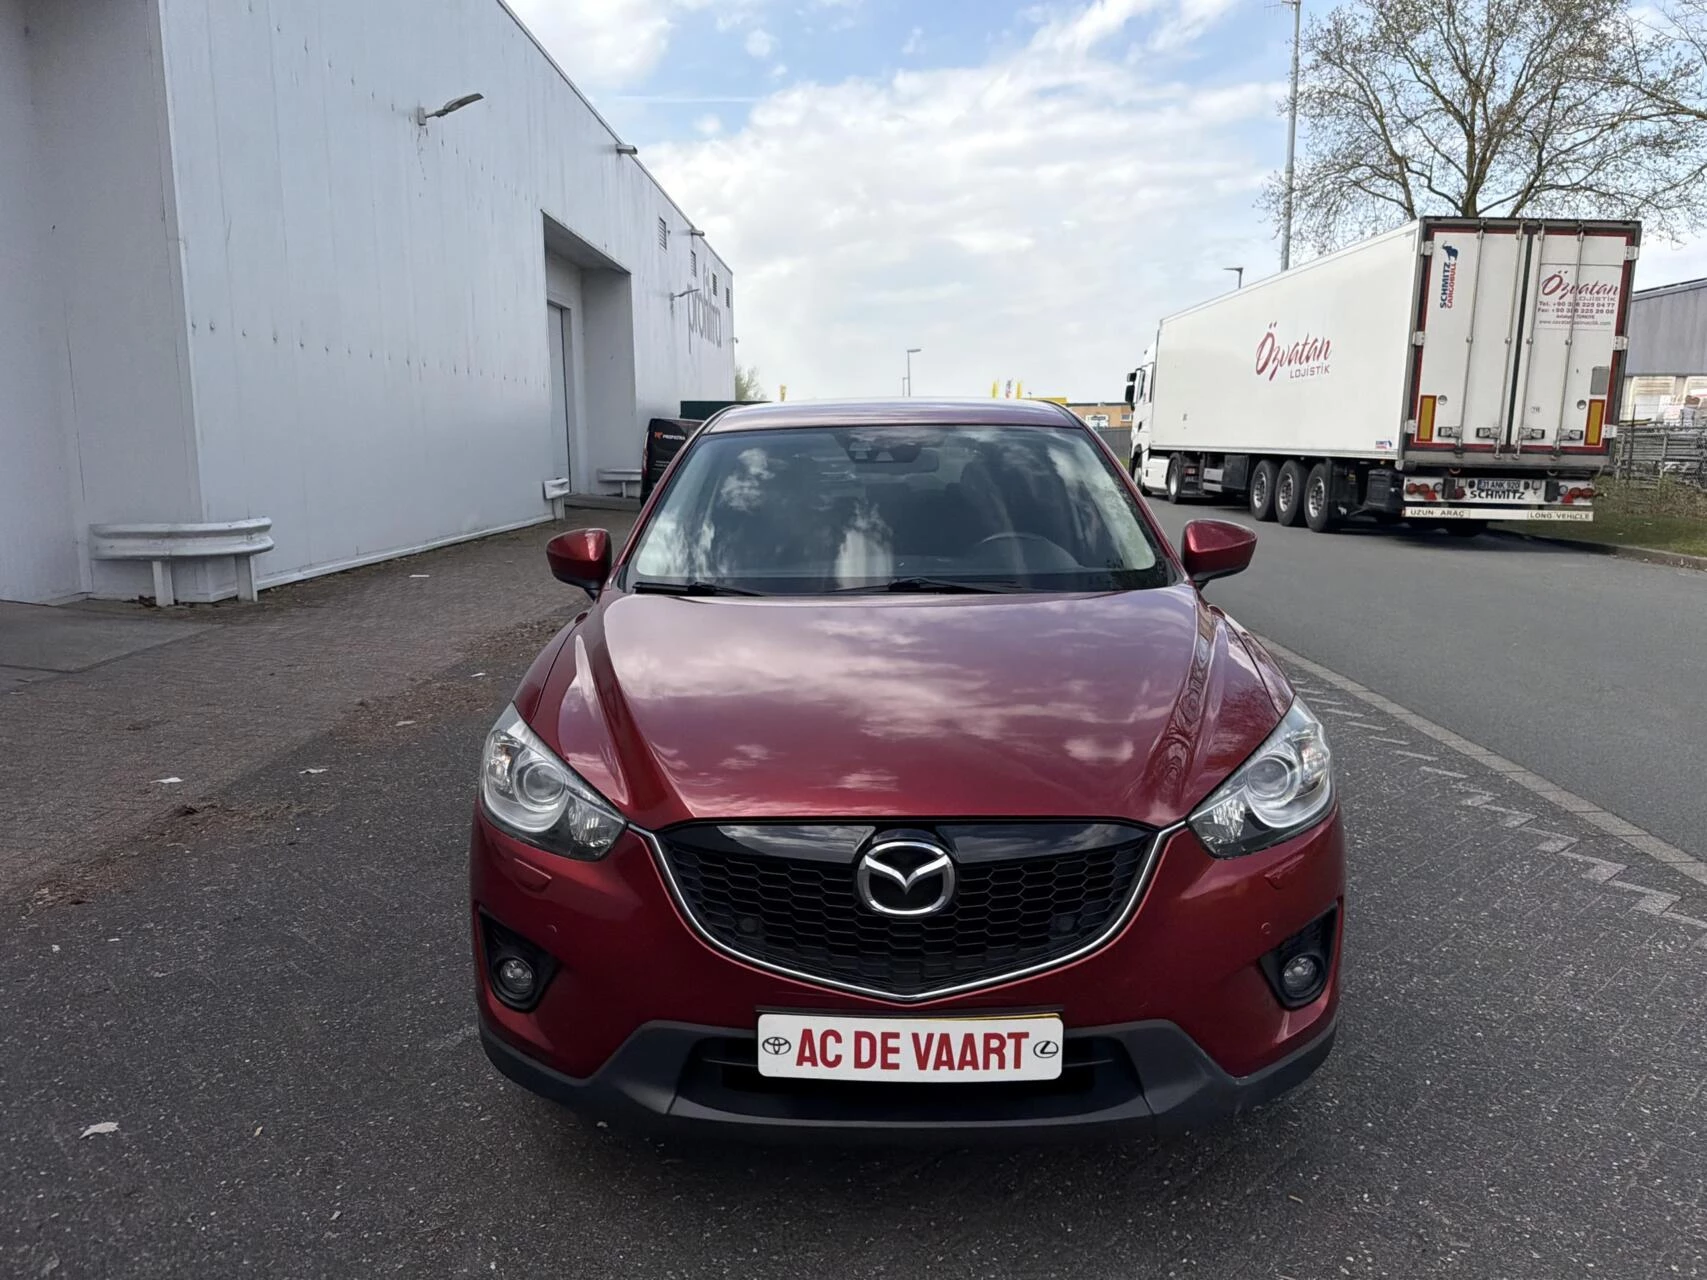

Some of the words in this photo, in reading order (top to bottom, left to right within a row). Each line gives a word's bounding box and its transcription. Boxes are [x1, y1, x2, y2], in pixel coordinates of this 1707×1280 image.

[1440, 262, 1451, 309] SCHMITZ
[1447, 263, 1457, 309] CARGOBULL
[1256, 321, 1332, 382] Özvatan
[1470, 489, 1525, 499] SCHMITZ
[796, 1028, 843, 1068] AC
[853, 1030, 901, 1070] DE
[911, 1031, 1029, 1071] VAART
